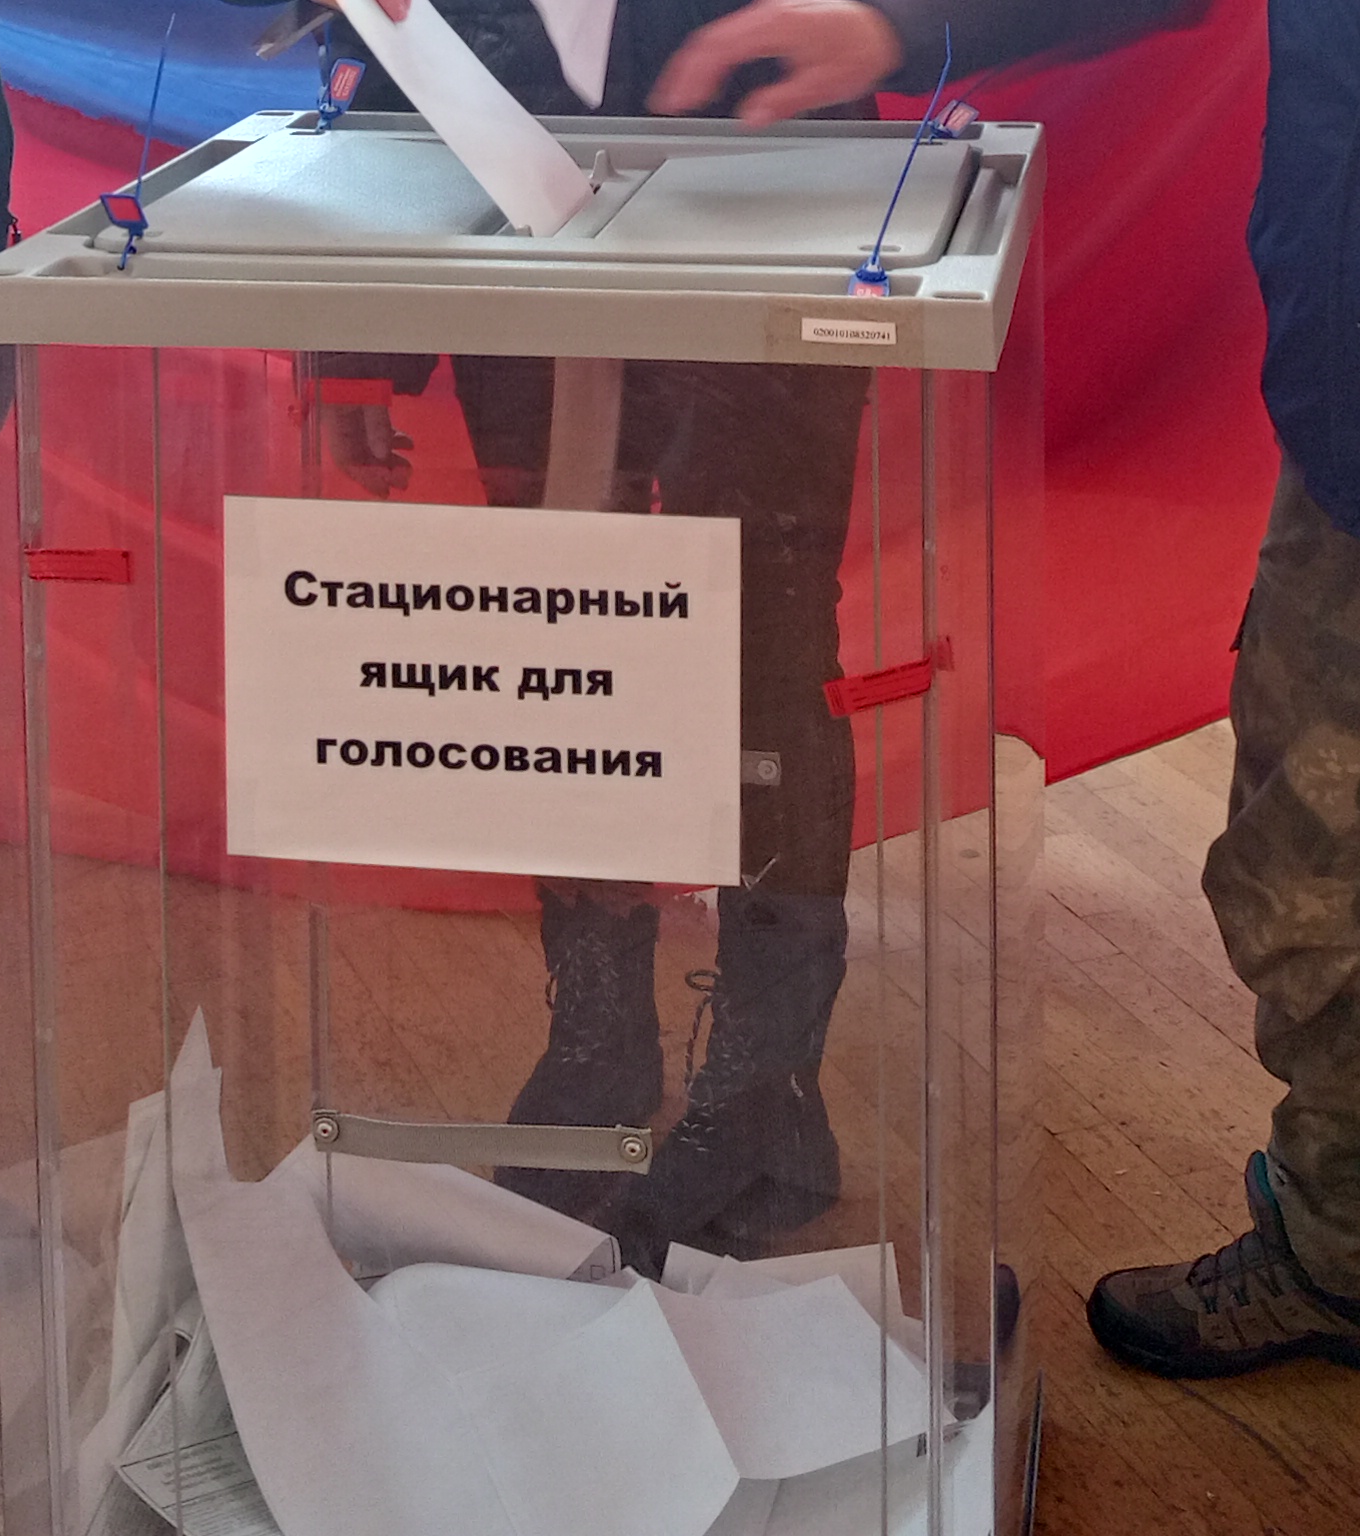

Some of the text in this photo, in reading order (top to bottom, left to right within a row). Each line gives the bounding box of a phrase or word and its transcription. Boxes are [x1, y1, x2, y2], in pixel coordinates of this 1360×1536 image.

[284, 570, 689, 624] Стационарный
[360, 661, 613, 701] ящик для
[316, 737, 663, 778] голосования
